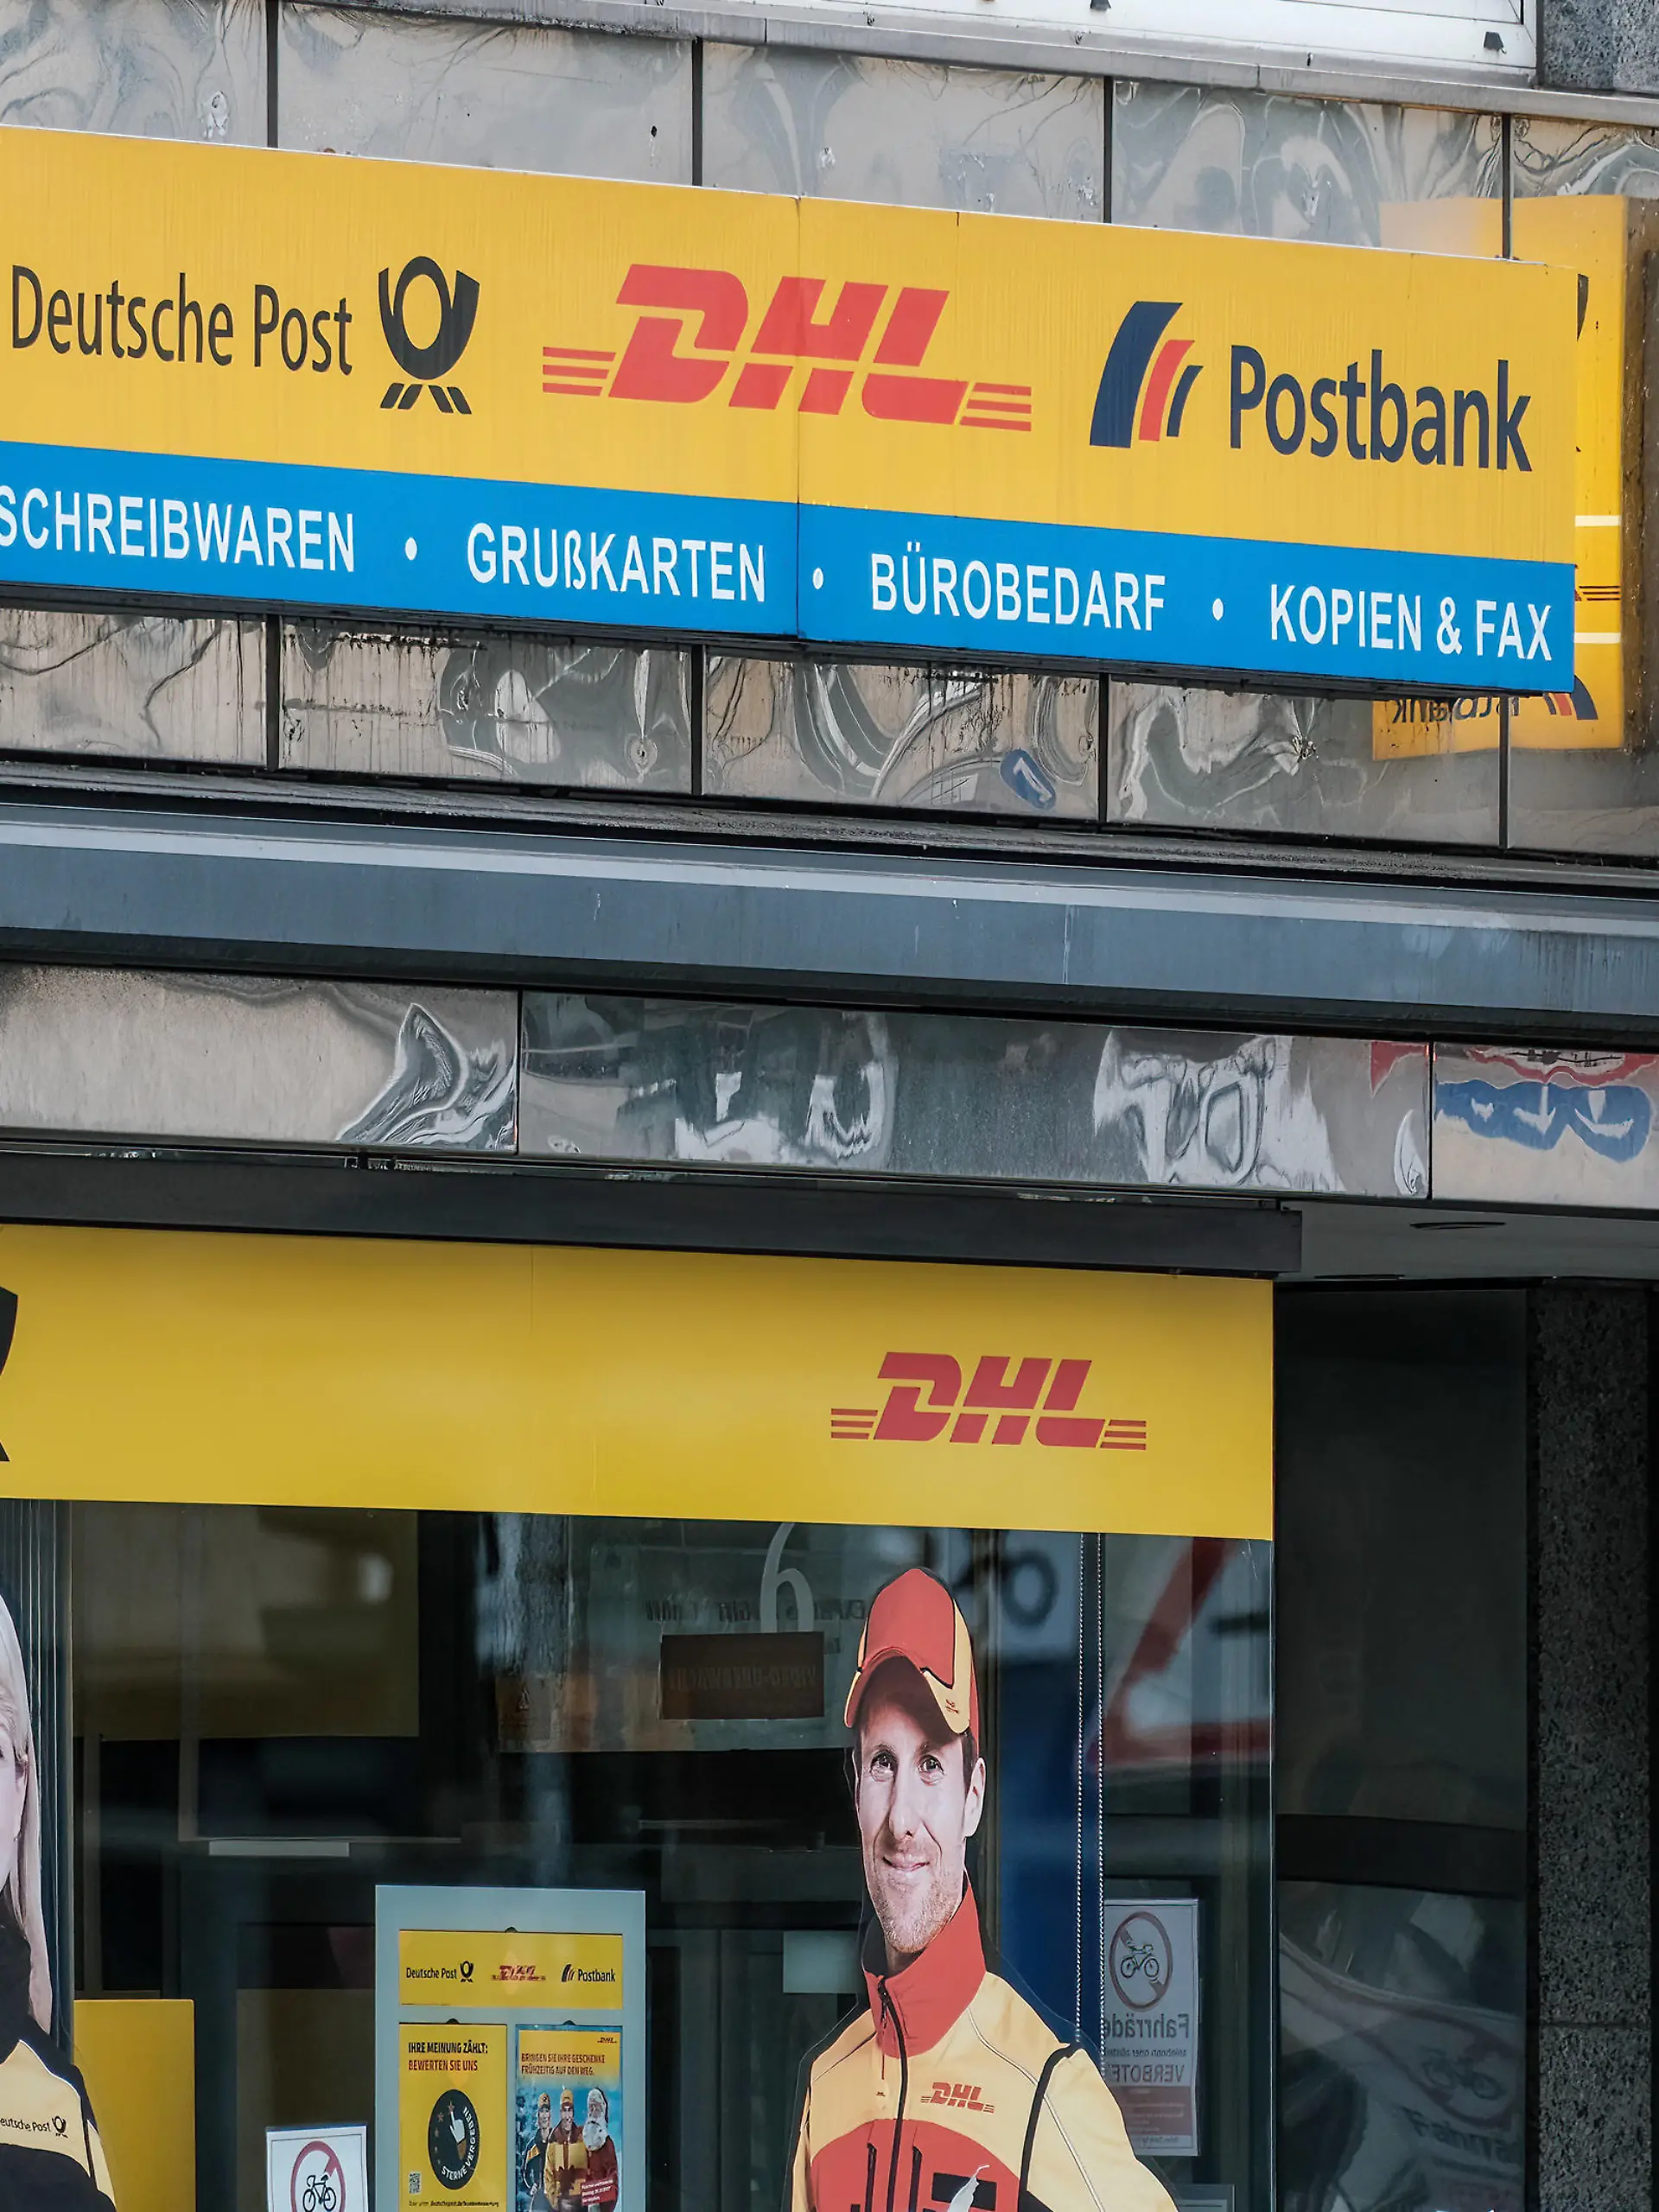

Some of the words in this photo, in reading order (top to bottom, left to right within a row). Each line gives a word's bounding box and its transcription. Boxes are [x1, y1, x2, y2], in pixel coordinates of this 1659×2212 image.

[12, 264, 234, 366] Deutsche
[254, 283, 353, 376] Post
[608, 264, 969, 425] DHL
[1230, 344, 1533, 473] Postbank
[0, 485, 354, 573] SCHREIBWAREN
[467, 523, 765, 602] GRUßKARTEN
[871, 541, 1166, 632] BÜROBEDARF
[1271, 583, 1421, 652] KOPIEN
[1436, 596, 1463, 654] &
[1476, 600, 1552, 661] FAX
[874, 1352, 1106, 1448] DHL
[406, 1967, 439, 1980] Deutsche
[441, 1967, 457, 1980] Post
[577, 1968, 615, 1983] Postbank
[408, 2042, 426, 2054] IHRE
[427, 2042, 461, 2054] MEINUNG
[462, 2039, 488, 2055] ZÄHLT:
[408, 2060, 448, 2071] BEWERTEN
[449, 2060, 461, 2071] SIE
[462, 2060, 478, 2071] UNS
[931, 2082, 984, 2112] DHL
[0, 2118, 31, 2132] eutsche
[32, 2121, 52, 2133] Post
